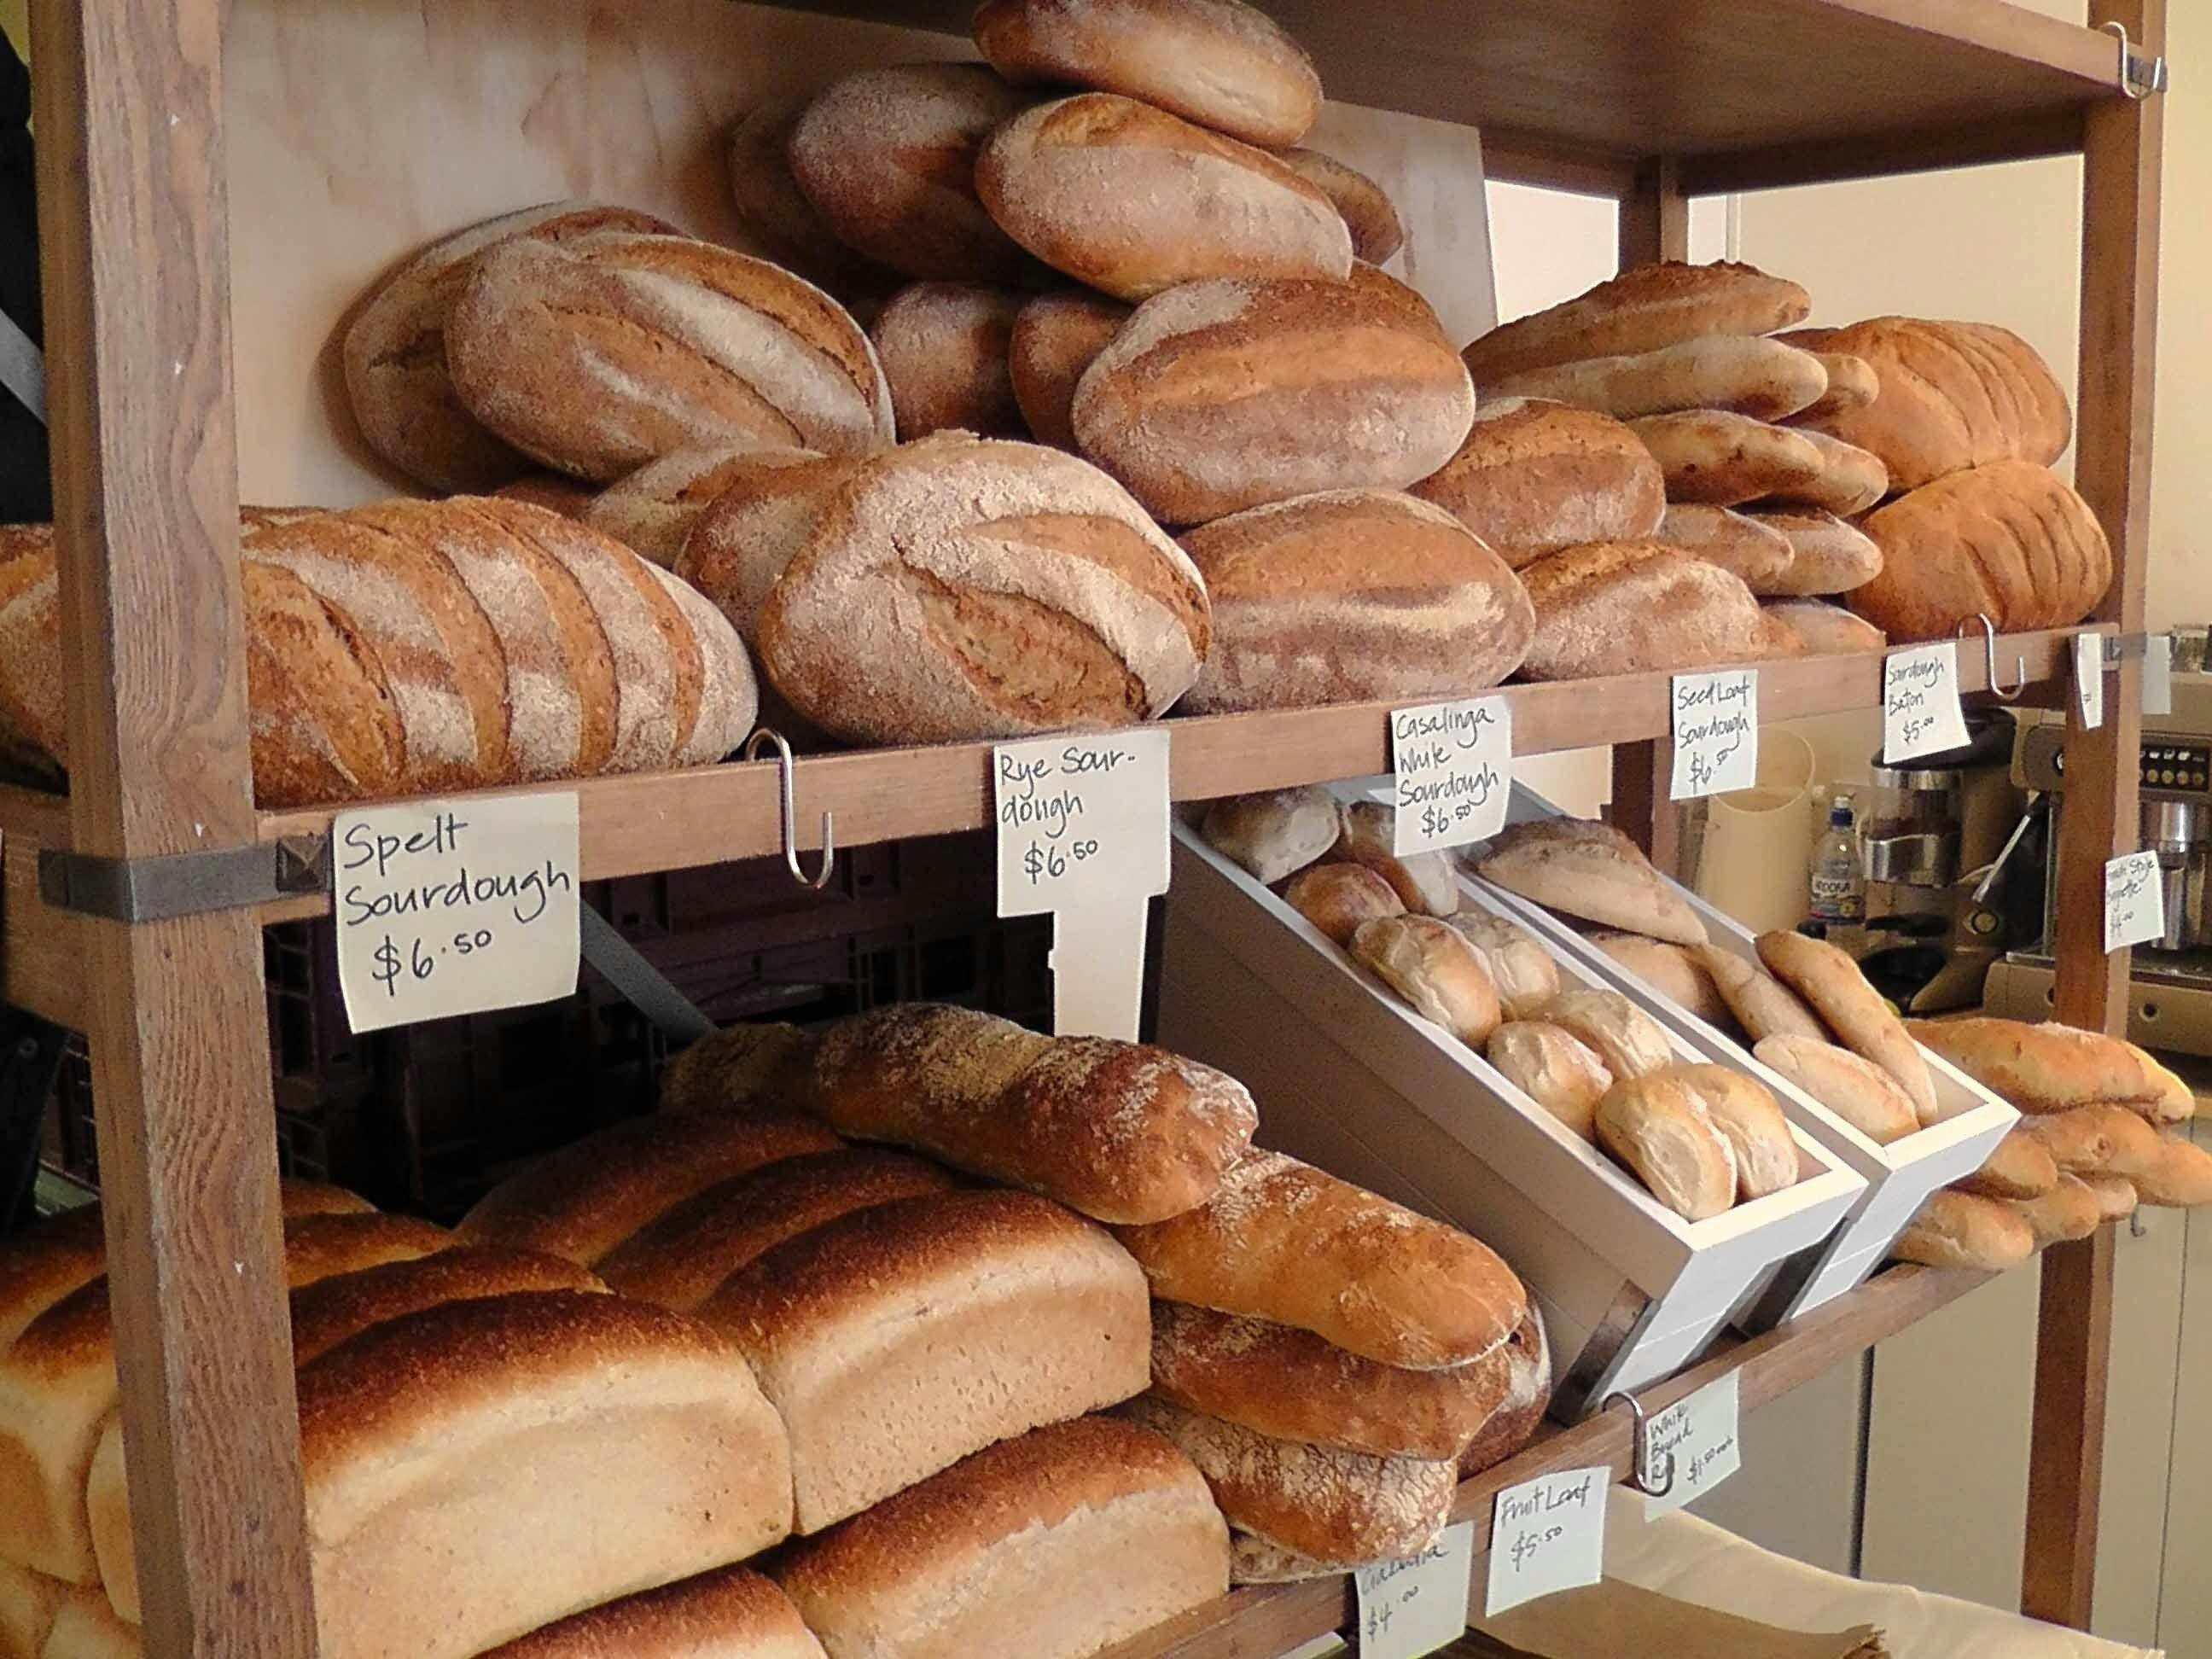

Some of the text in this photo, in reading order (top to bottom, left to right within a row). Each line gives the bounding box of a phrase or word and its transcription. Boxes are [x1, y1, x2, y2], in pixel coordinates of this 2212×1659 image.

[1396, 707, 1494, 748] Casalinga
[1000, 754, 1052, 800] Rye
[1399, 742, 1451, 774] White
[1400, 762, 1499, 807] Sourdough
[1002, 790, 1083, 839] dough
[344, 812, 469, 876] Spelt
[346, 860, 571, 926] Sourdough
[372, 929, 492, 997] $6.50
[1501, 1486, 1544, 1528] Fruit
